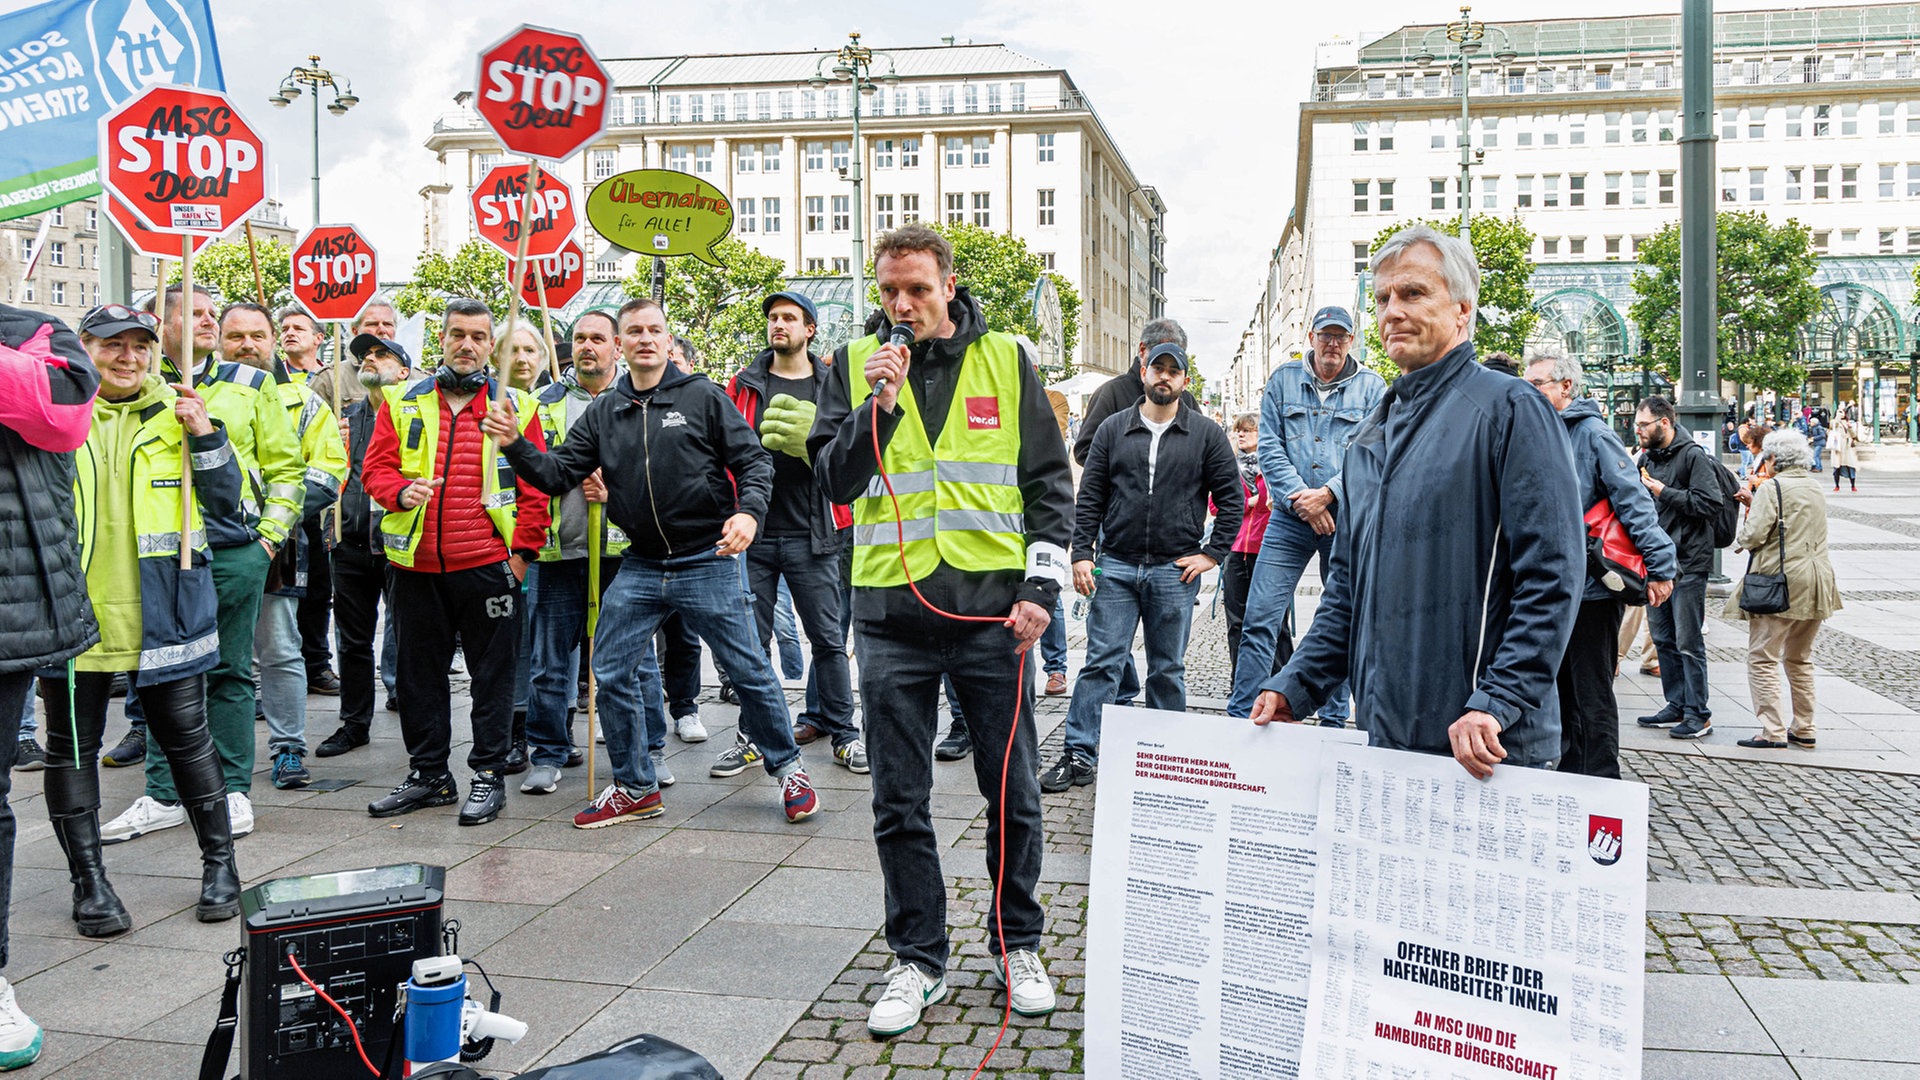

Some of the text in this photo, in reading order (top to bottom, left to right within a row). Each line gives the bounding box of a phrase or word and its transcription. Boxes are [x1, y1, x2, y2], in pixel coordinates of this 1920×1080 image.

[512, 44, 584, 74] MSC
[485, 59, 603, 117] STOP
[145, 105, 231, 138] MSC
[504, 100, 578, 130] Deal
[118, 125, 258, 184] STOP
[144, 167, 233, 203] Deal
[495, 170, 546, 202] MSC
[609, 178, 730, 216] Übernahme
[479, 189, 567, 226] STOP
[618, 213, 637, 232] für
[311, 232, 357, 263] MSC
[298, 253, 373, 286] STOP
[311, 273, 359, 304] Deal
[968, 416, 998, 426] ver.di
[485, 594, 514, 619] 63
[1136, 751, 1230, 771] SEHR GEEHRTER HERR KAHN,
[1136, 760, 1235, 780] SEHR GEEHRTE ABGEORDNETE
[1135, 770, 1266, 794] DER HAMBURGISCHEN BÜRGERSCHAFT,
[1397, 940, 1544, 991] OFFENER BRIEF DER
[1414, 1010, 1517, 1050] AN MSC UND DIE
[1374, 1021, 1452, 1056] HAMBURGER
[1454, 1041, 1558, 1080] BÜRGERSCHAFT
